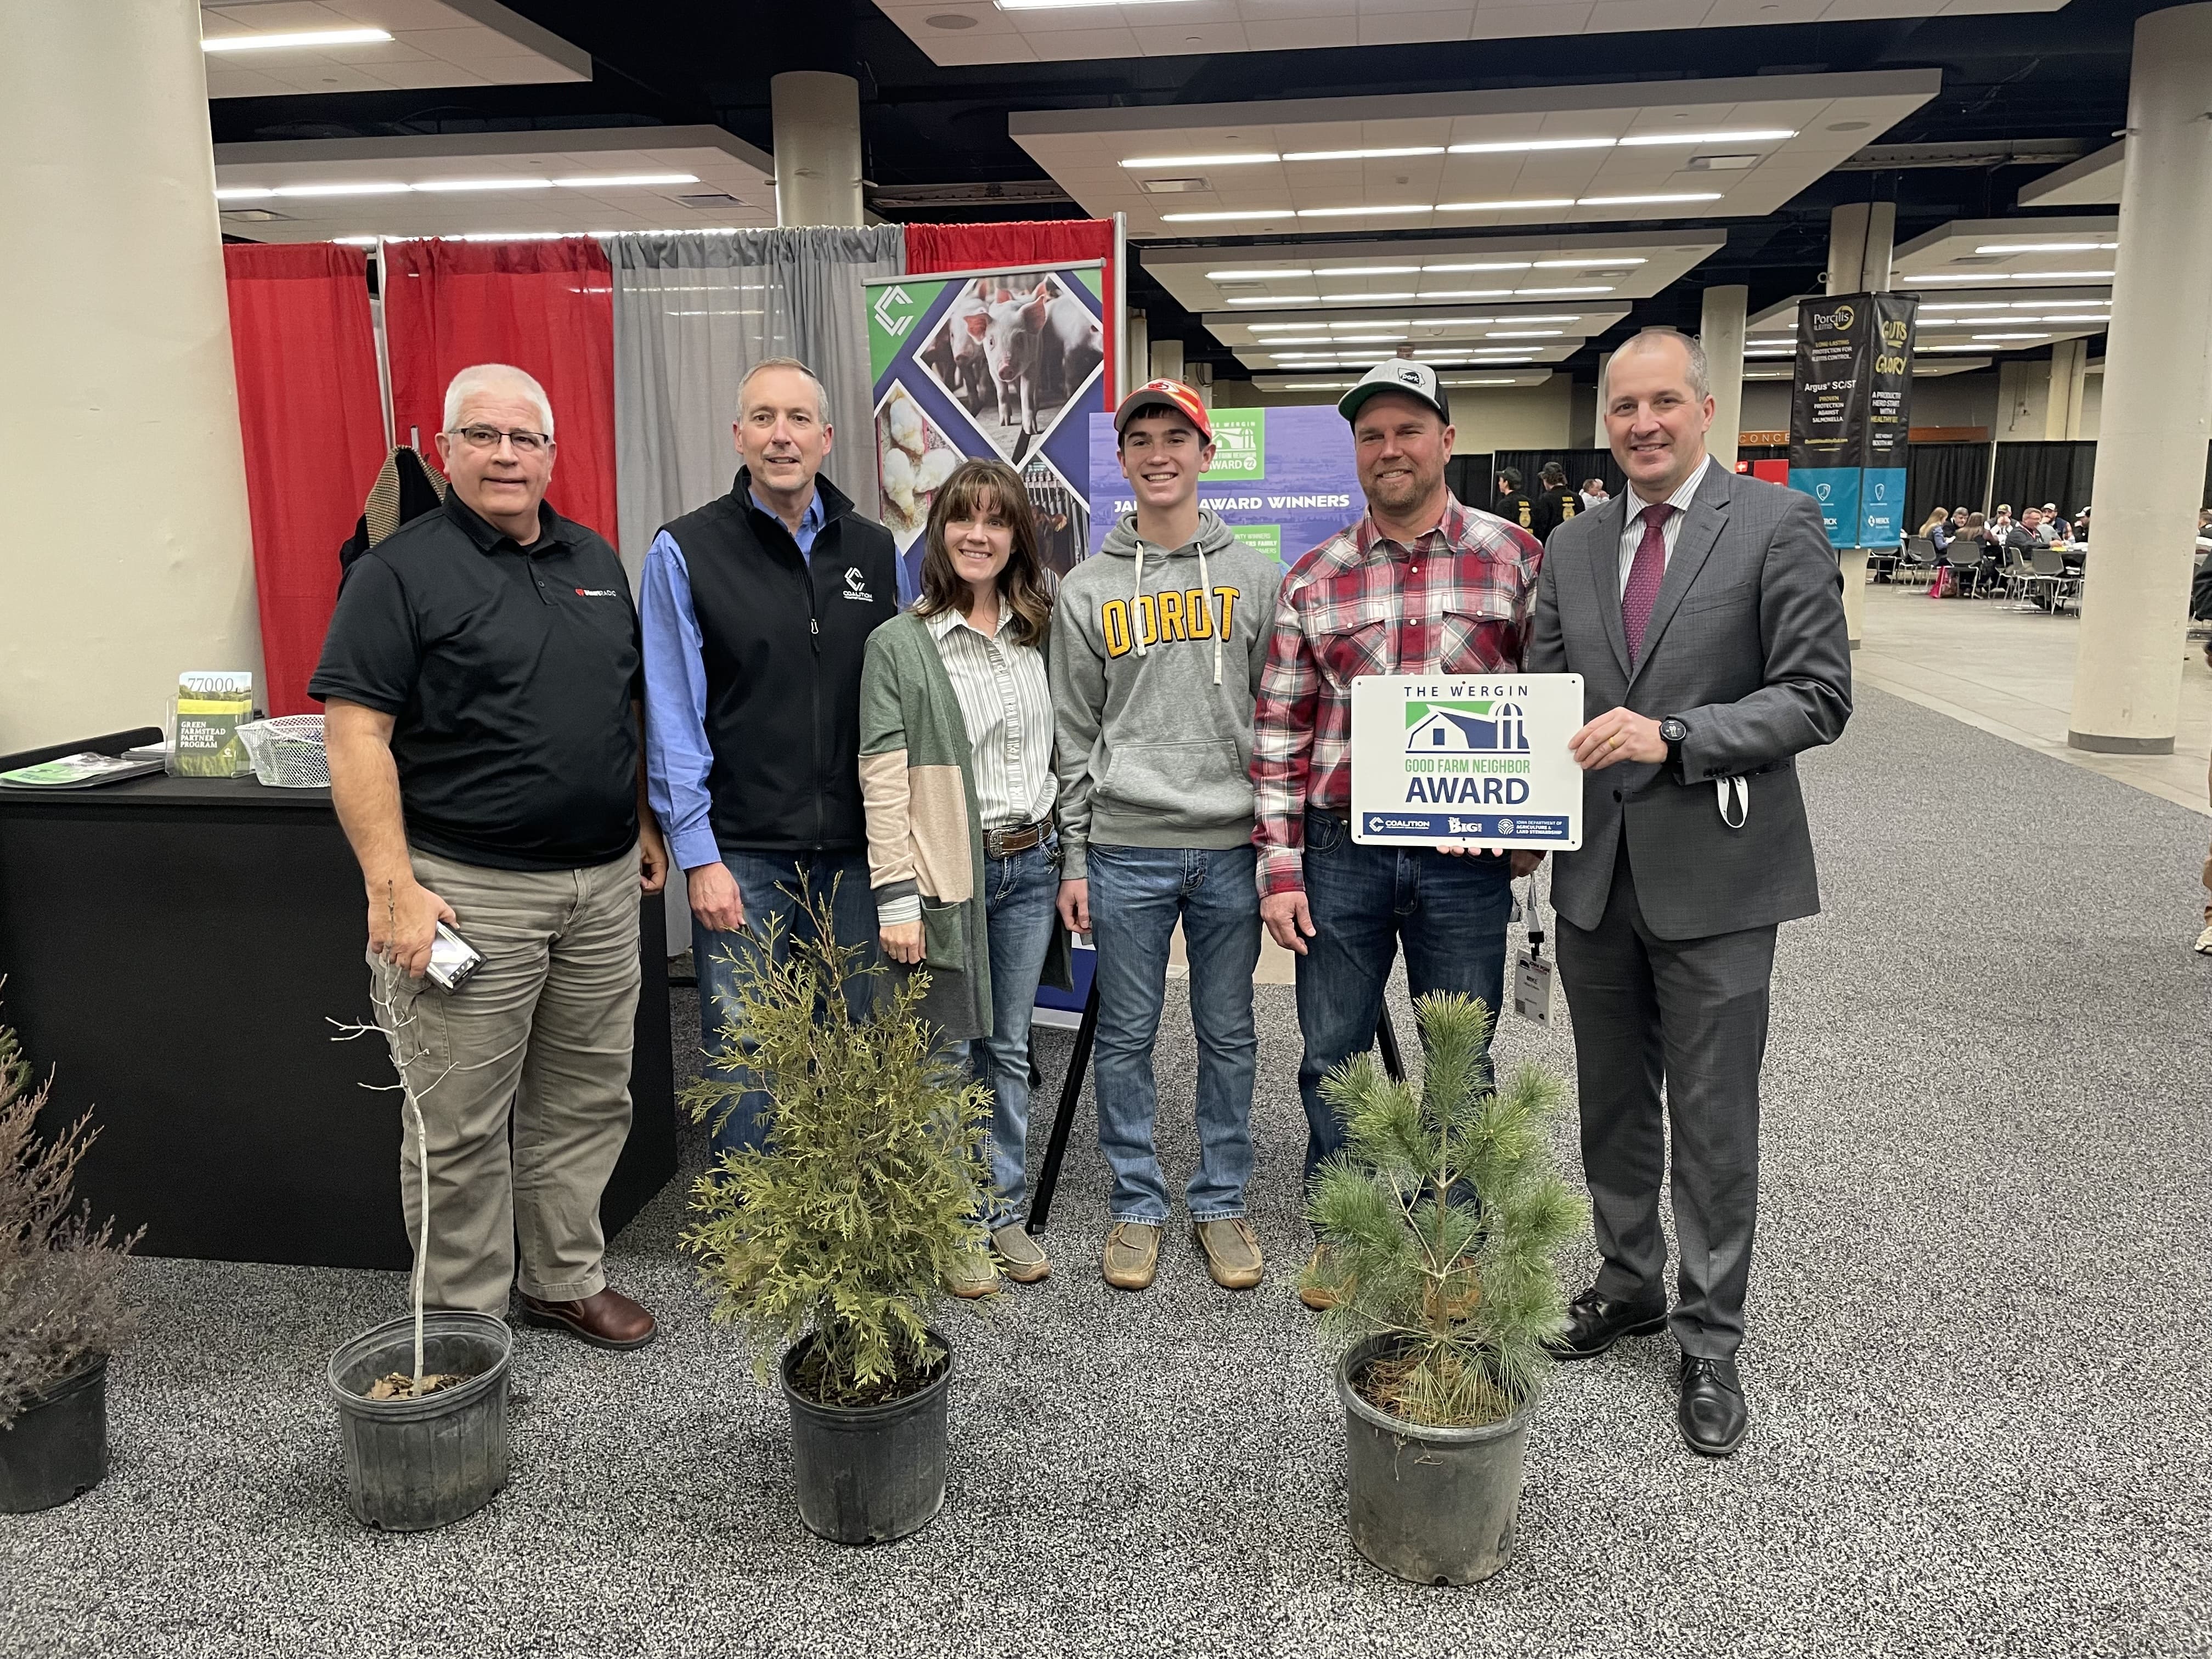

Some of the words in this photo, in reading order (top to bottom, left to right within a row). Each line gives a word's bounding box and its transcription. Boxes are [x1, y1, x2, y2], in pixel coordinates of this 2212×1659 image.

[1814, 312, 1849, 325] Porcilis
[1881, 320, 1908, 341] GUTS
[1876, 354, 1908, 375] GLORY
[1832, 380, 1857, 390] SC/ST
[1199, 497, 1262, 510] AWARD
[1267, 495, 1350, 509] WINNERS
[188, 678, 234, 692] 77000
[1404, 686, 1438, 697] THE
[1451, 685, 1528, 697] WERGIN
[1405, 759, 1434, 772] GOOD
[1438, 759, 1469, 773] FARM
[1473, 759, 1530, 774] NEIGHBOR
[1405, 777, 1530, 804] AWARD
